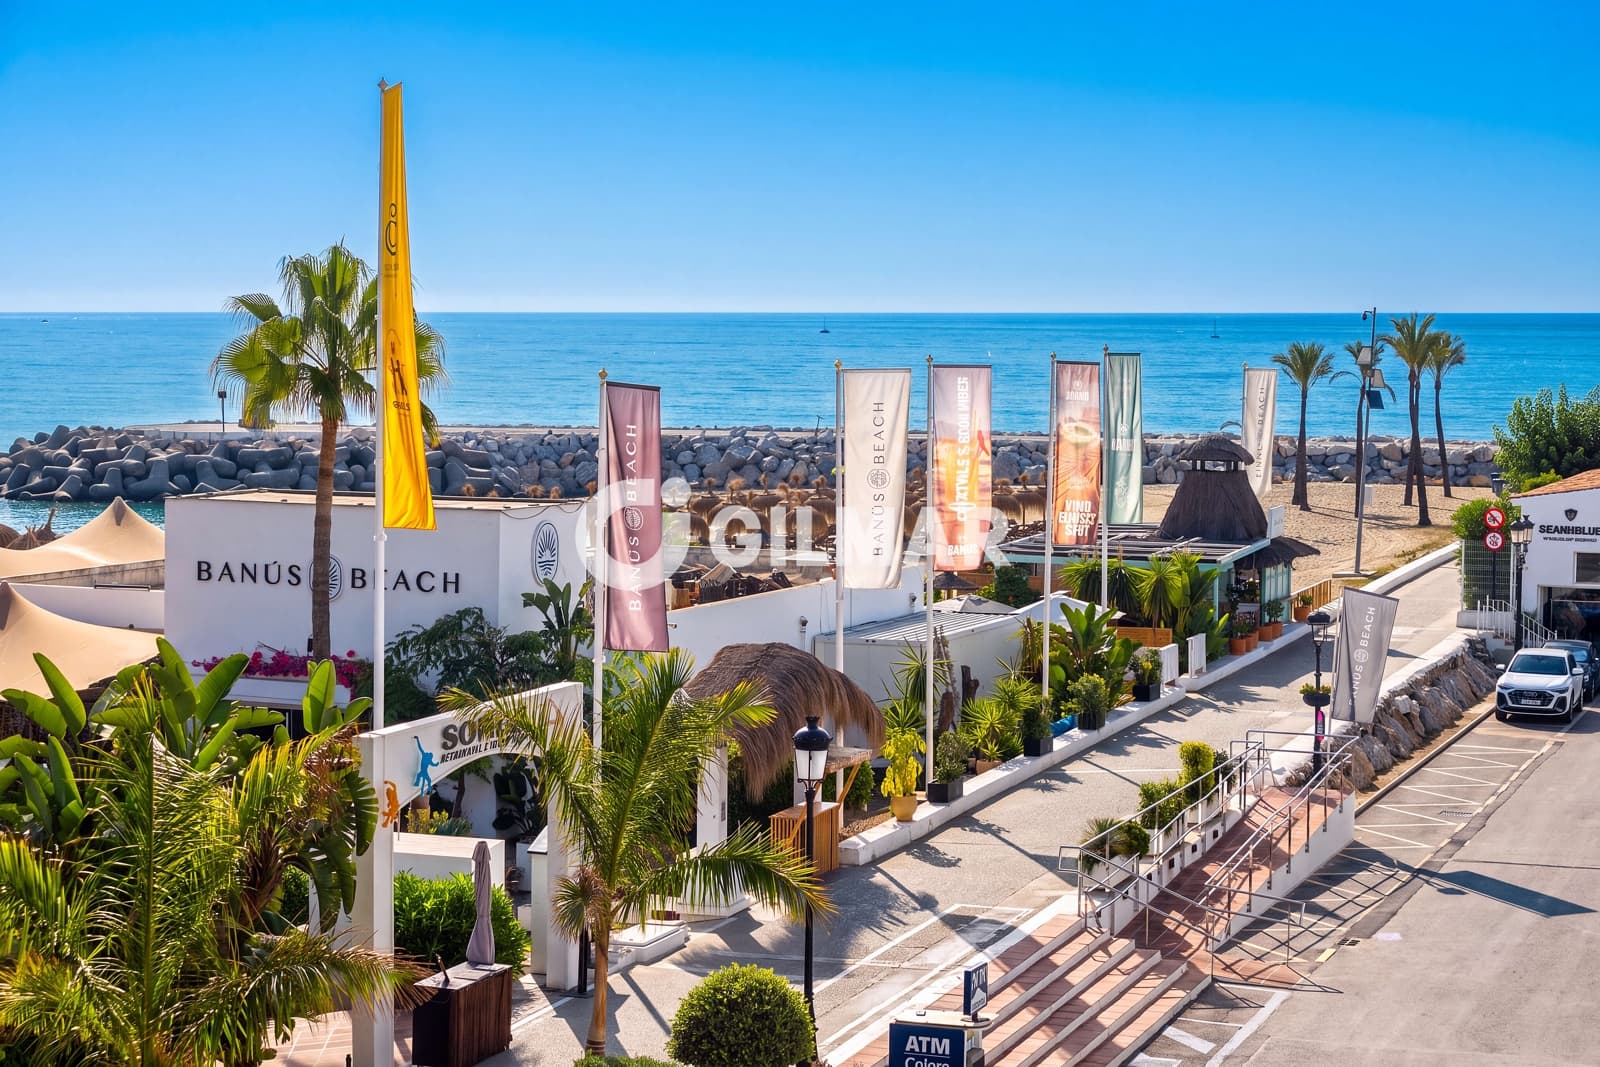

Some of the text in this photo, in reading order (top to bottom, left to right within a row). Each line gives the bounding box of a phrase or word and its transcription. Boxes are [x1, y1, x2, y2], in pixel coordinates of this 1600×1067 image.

[872, 402, 885, 464] BEACH
[626, 424, 637, 502] BEACH
[196, 560, 302, 587] BANÚS
[1359, 606, 1376, 648] BEACH
[904, 1034, 951, 1056] ATM
